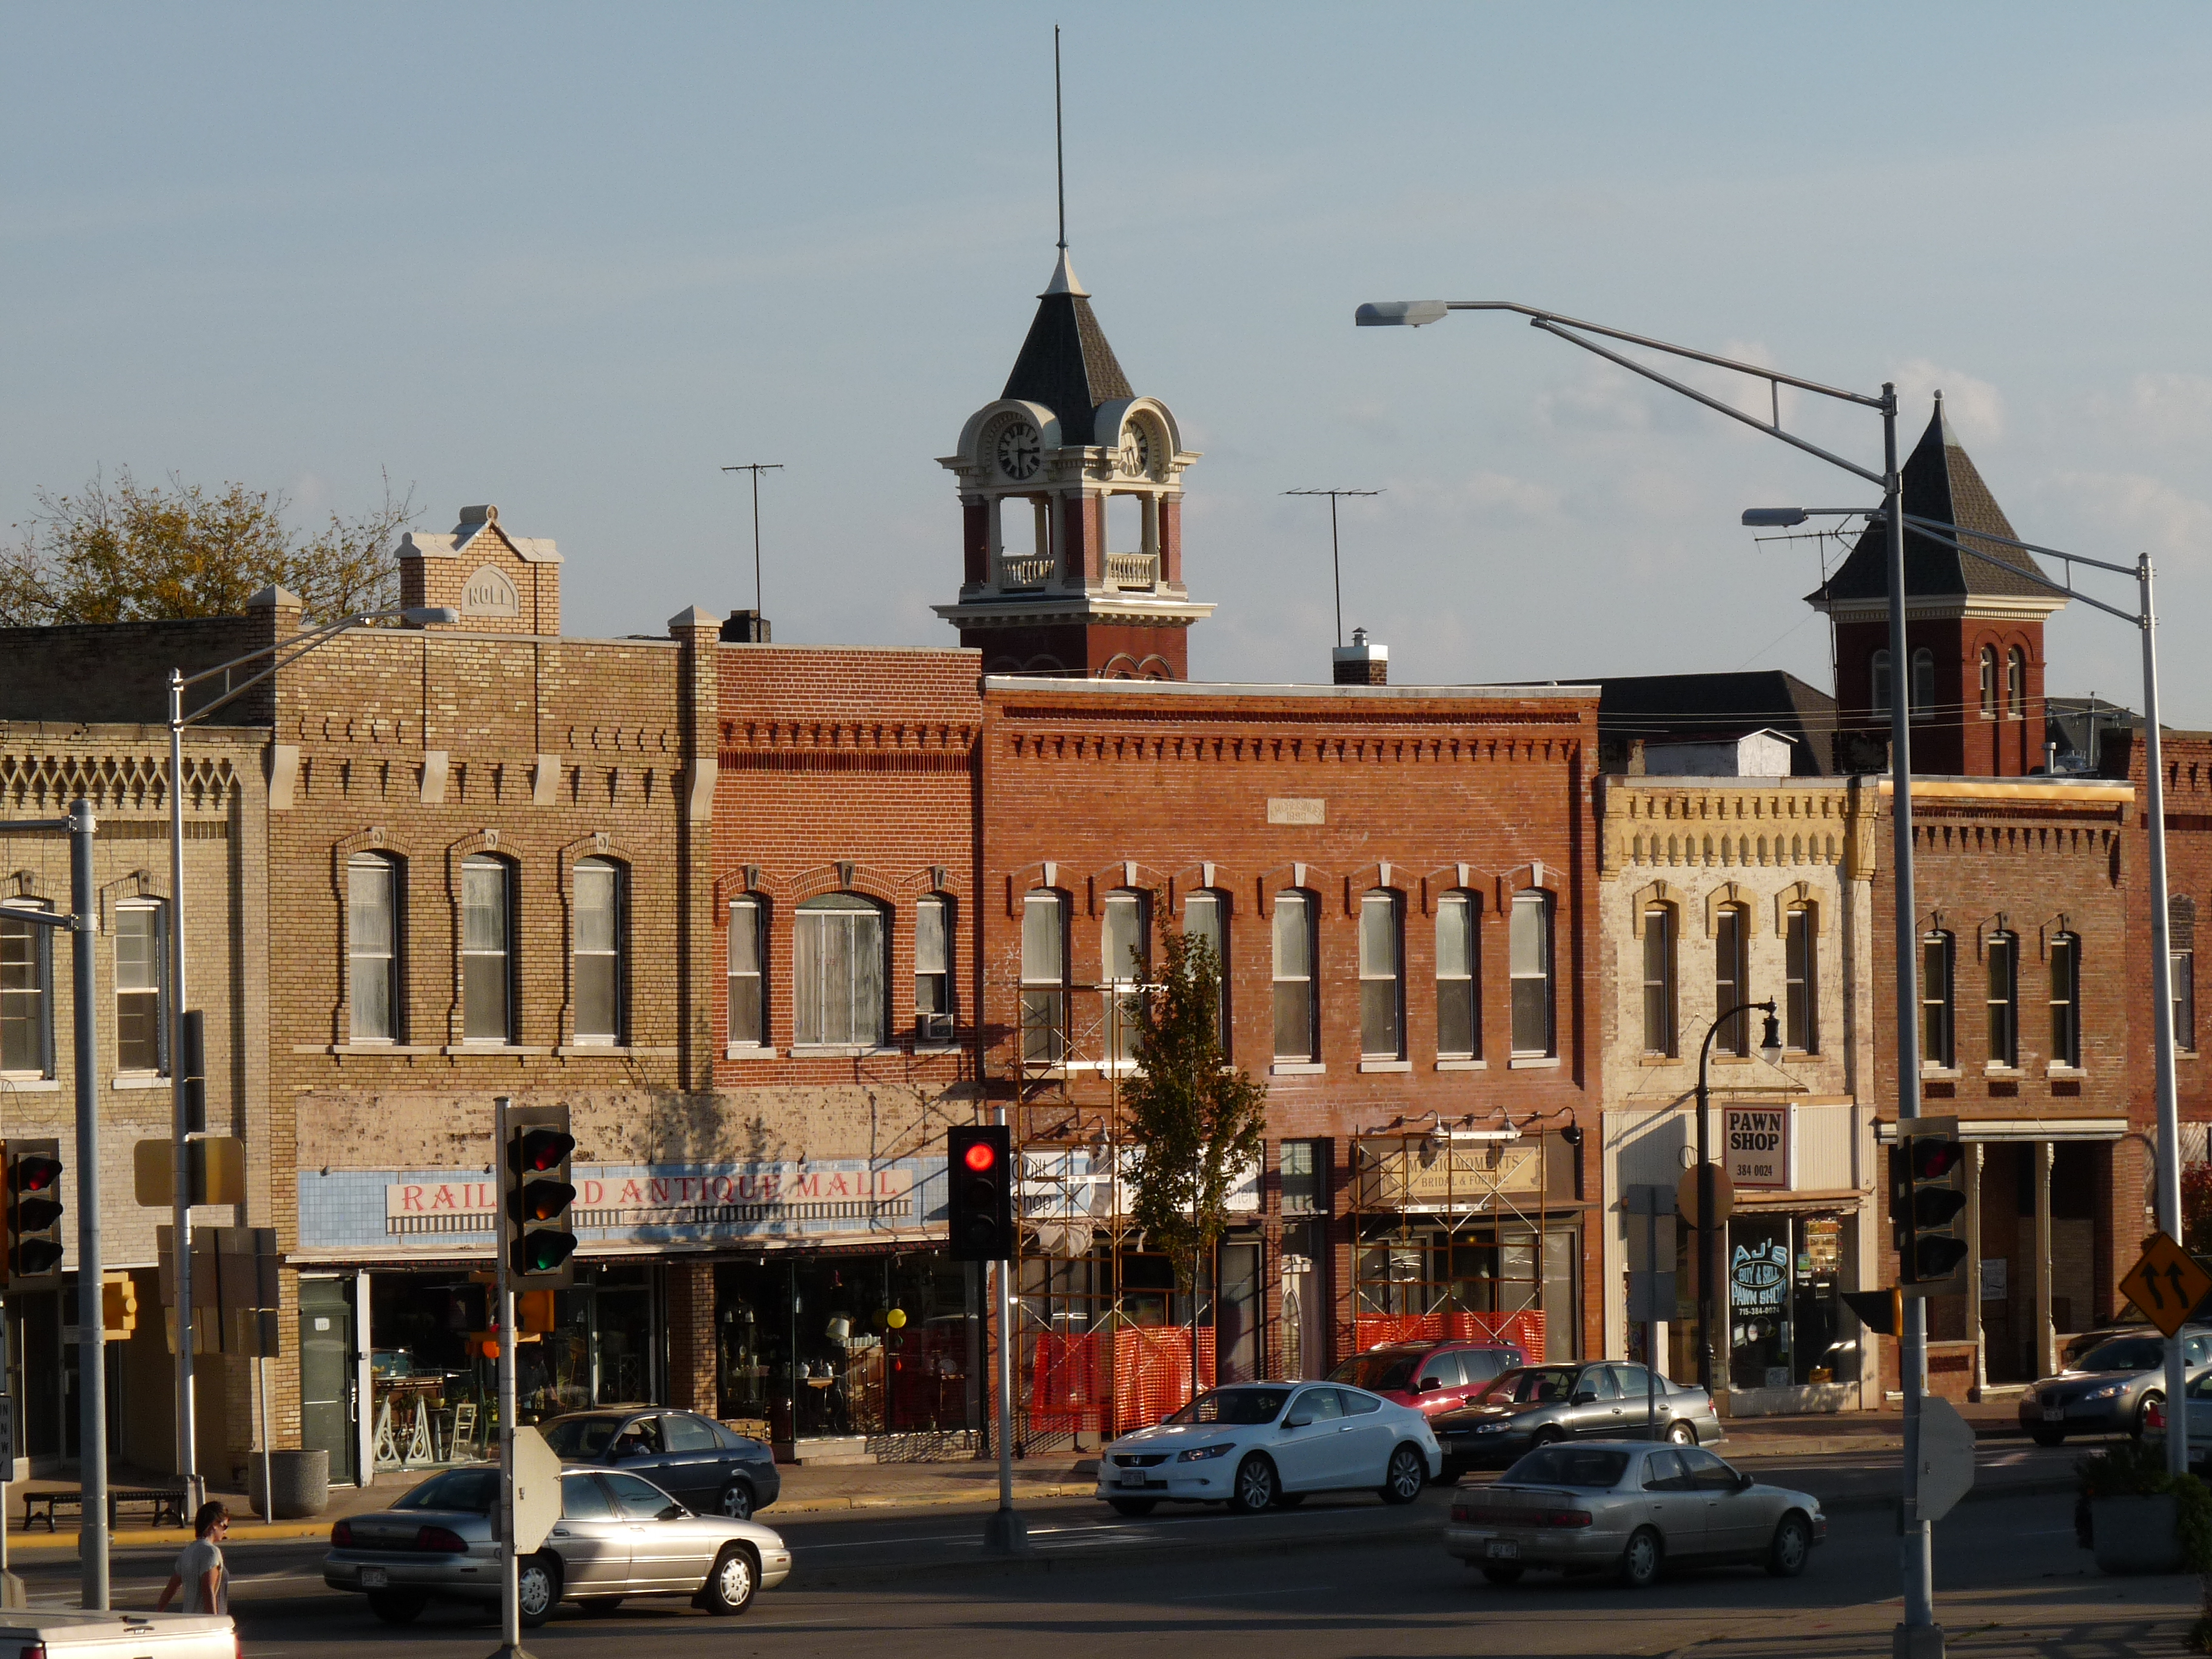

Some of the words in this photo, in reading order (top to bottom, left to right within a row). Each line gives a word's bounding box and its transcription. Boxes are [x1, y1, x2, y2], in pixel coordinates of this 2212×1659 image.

[469, 585, 511, 606] NOLL
[1729, 1113, 1781, 1131] PAWN
[1731, 1133, 1779, 1150] SHOP
[1011, 1159, 1048, 1181] Quilt
[1460, 1176, 1466, 1185] &
[1737, 1165, 1751, 1176] 384
[1754, 1165, 1772, 1176] 0024
[401, 1179, 605, 1212] RAILD
[619, 1175, 782, 1204] ANTIQUE
[796, 1171, 899, 1198] MALL
[1012, 1191, 1051, 1215] Shop
[1732, 1238, 1787, 1269] AJ'S
[1738, 1263, 1755, 1284] BUY
[1756, 1265, 1762, 1284] &
[1763, 1265, 1779, 1284] SELL
[1732, 1281, 1757, 1305] PAWN
[1760, 1279, 1787, 1305] SHOP
